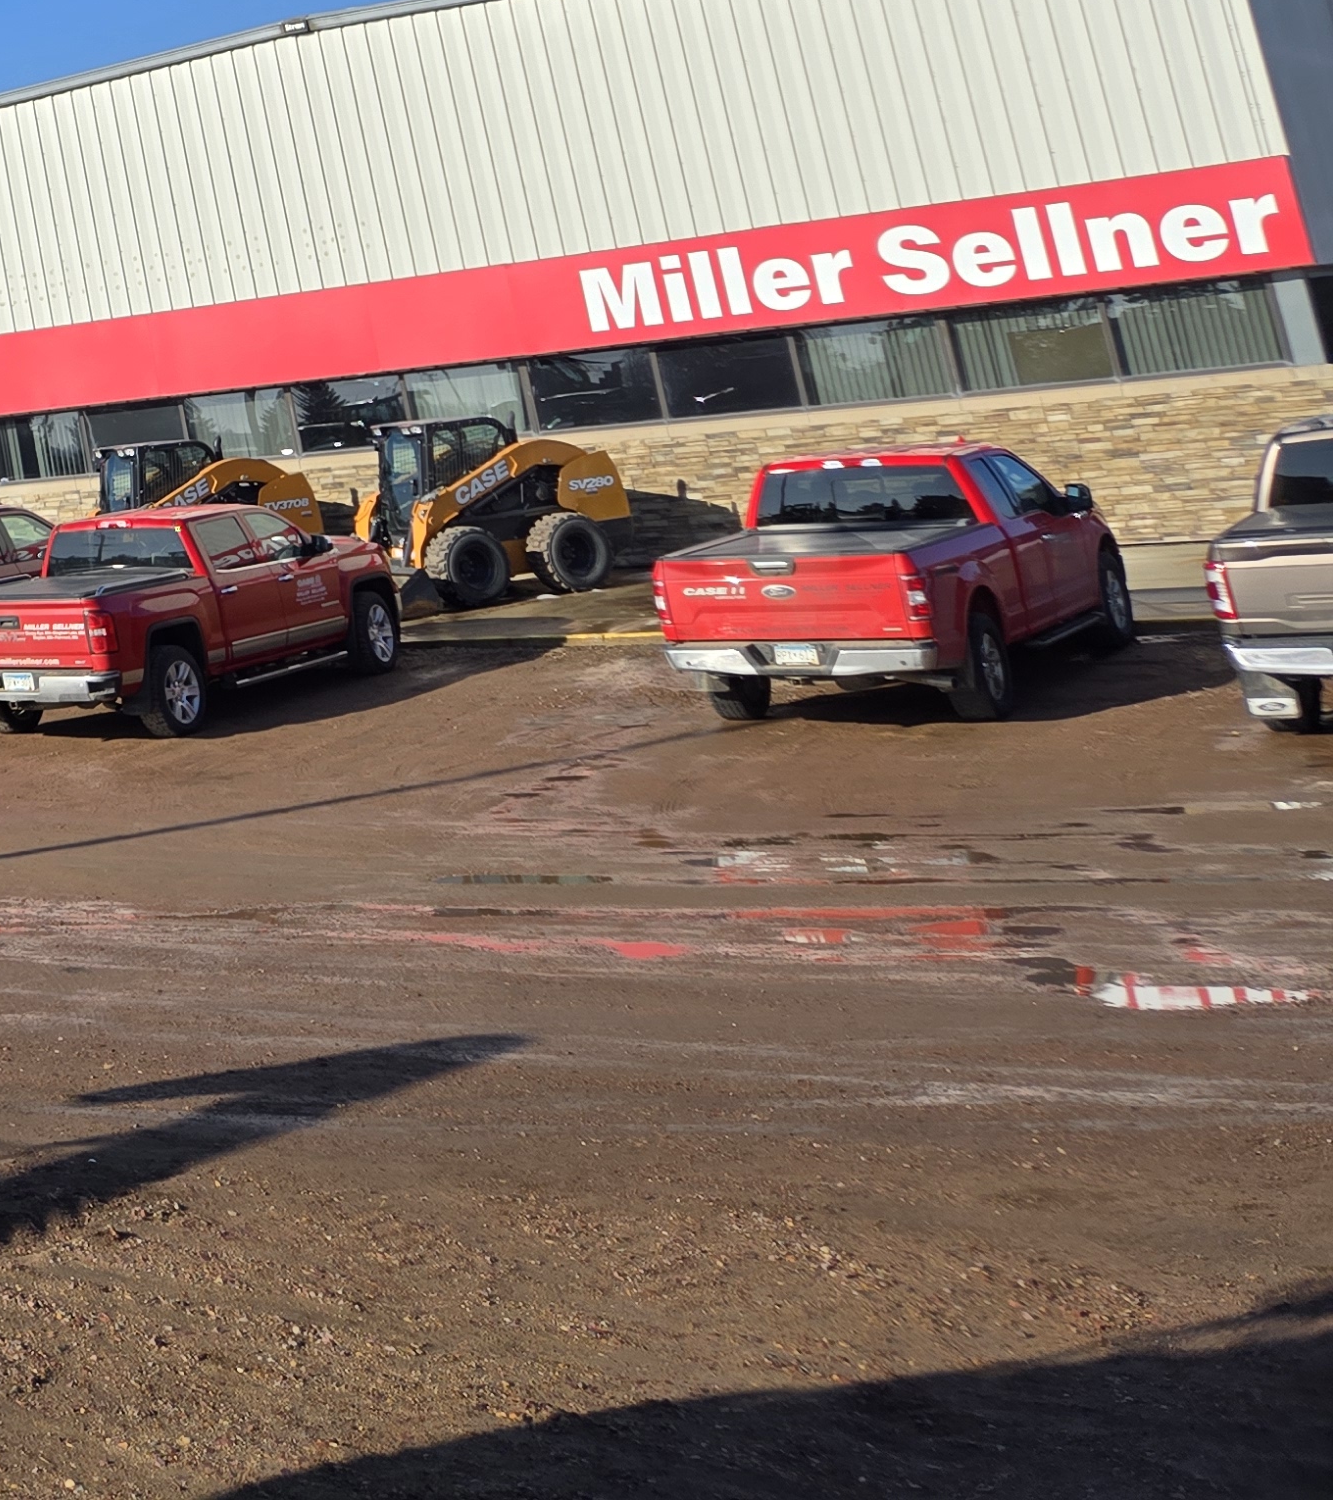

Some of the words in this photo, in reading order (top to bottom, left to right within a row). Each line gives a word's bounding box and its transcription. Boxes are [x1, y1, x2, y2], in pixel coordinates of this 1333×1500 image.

[578, 245, 853, 333] Miller
[875, 193, 1280, 296] Sellner
[455, 459, 510, 505] CASE
[568, 475, 615, 491] SV280
[162, 477, 210, 507] ASE
[264, 497, 310, 512] TV370B
[683, 587, 727, 596] CASE
[23, 623, 50, 631] MILLER
[52, 623, 85, 631] SELLNER
